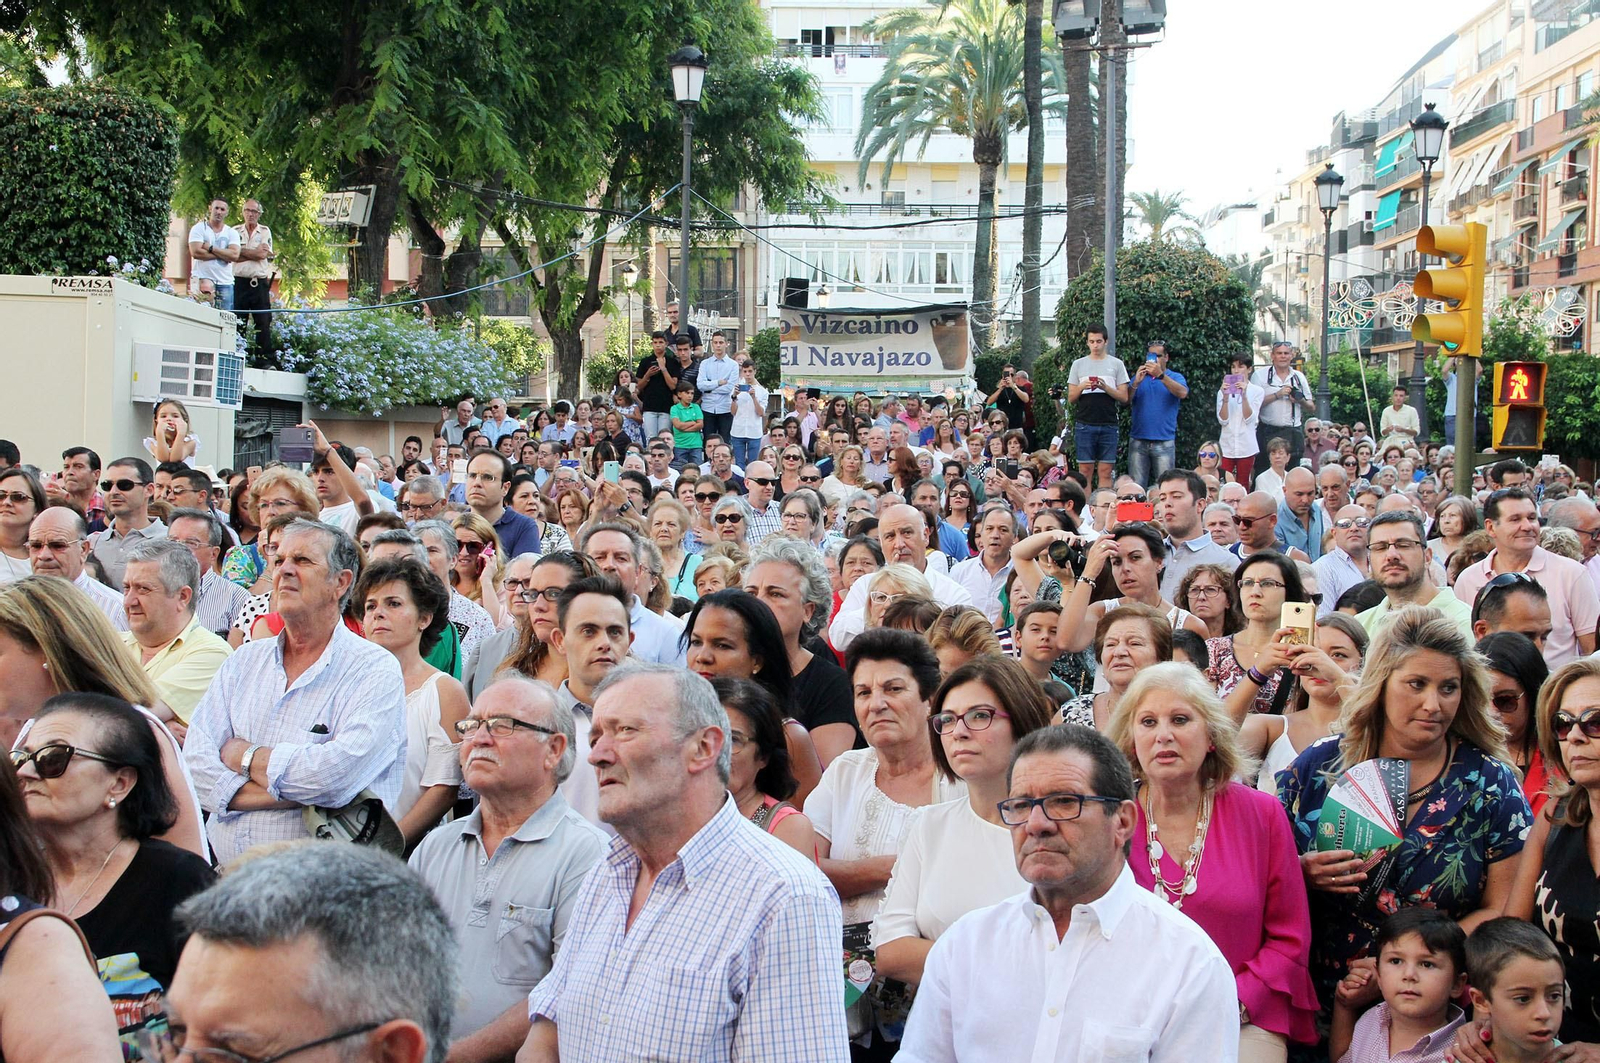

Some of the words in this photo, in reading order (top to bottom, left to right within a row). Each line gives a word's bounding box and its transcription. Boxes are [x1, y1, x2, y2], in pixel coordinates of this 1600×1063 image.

[58, 278, 113, 288] REMSA
[800, 314, 918, 334] Vizcaino
[780, 346, 799, 366] El
[808, 346, 931, 373] Navajazo
[1397, 760, 1405, 788] LALO
[1396, 793, 1406, 820] CASA
